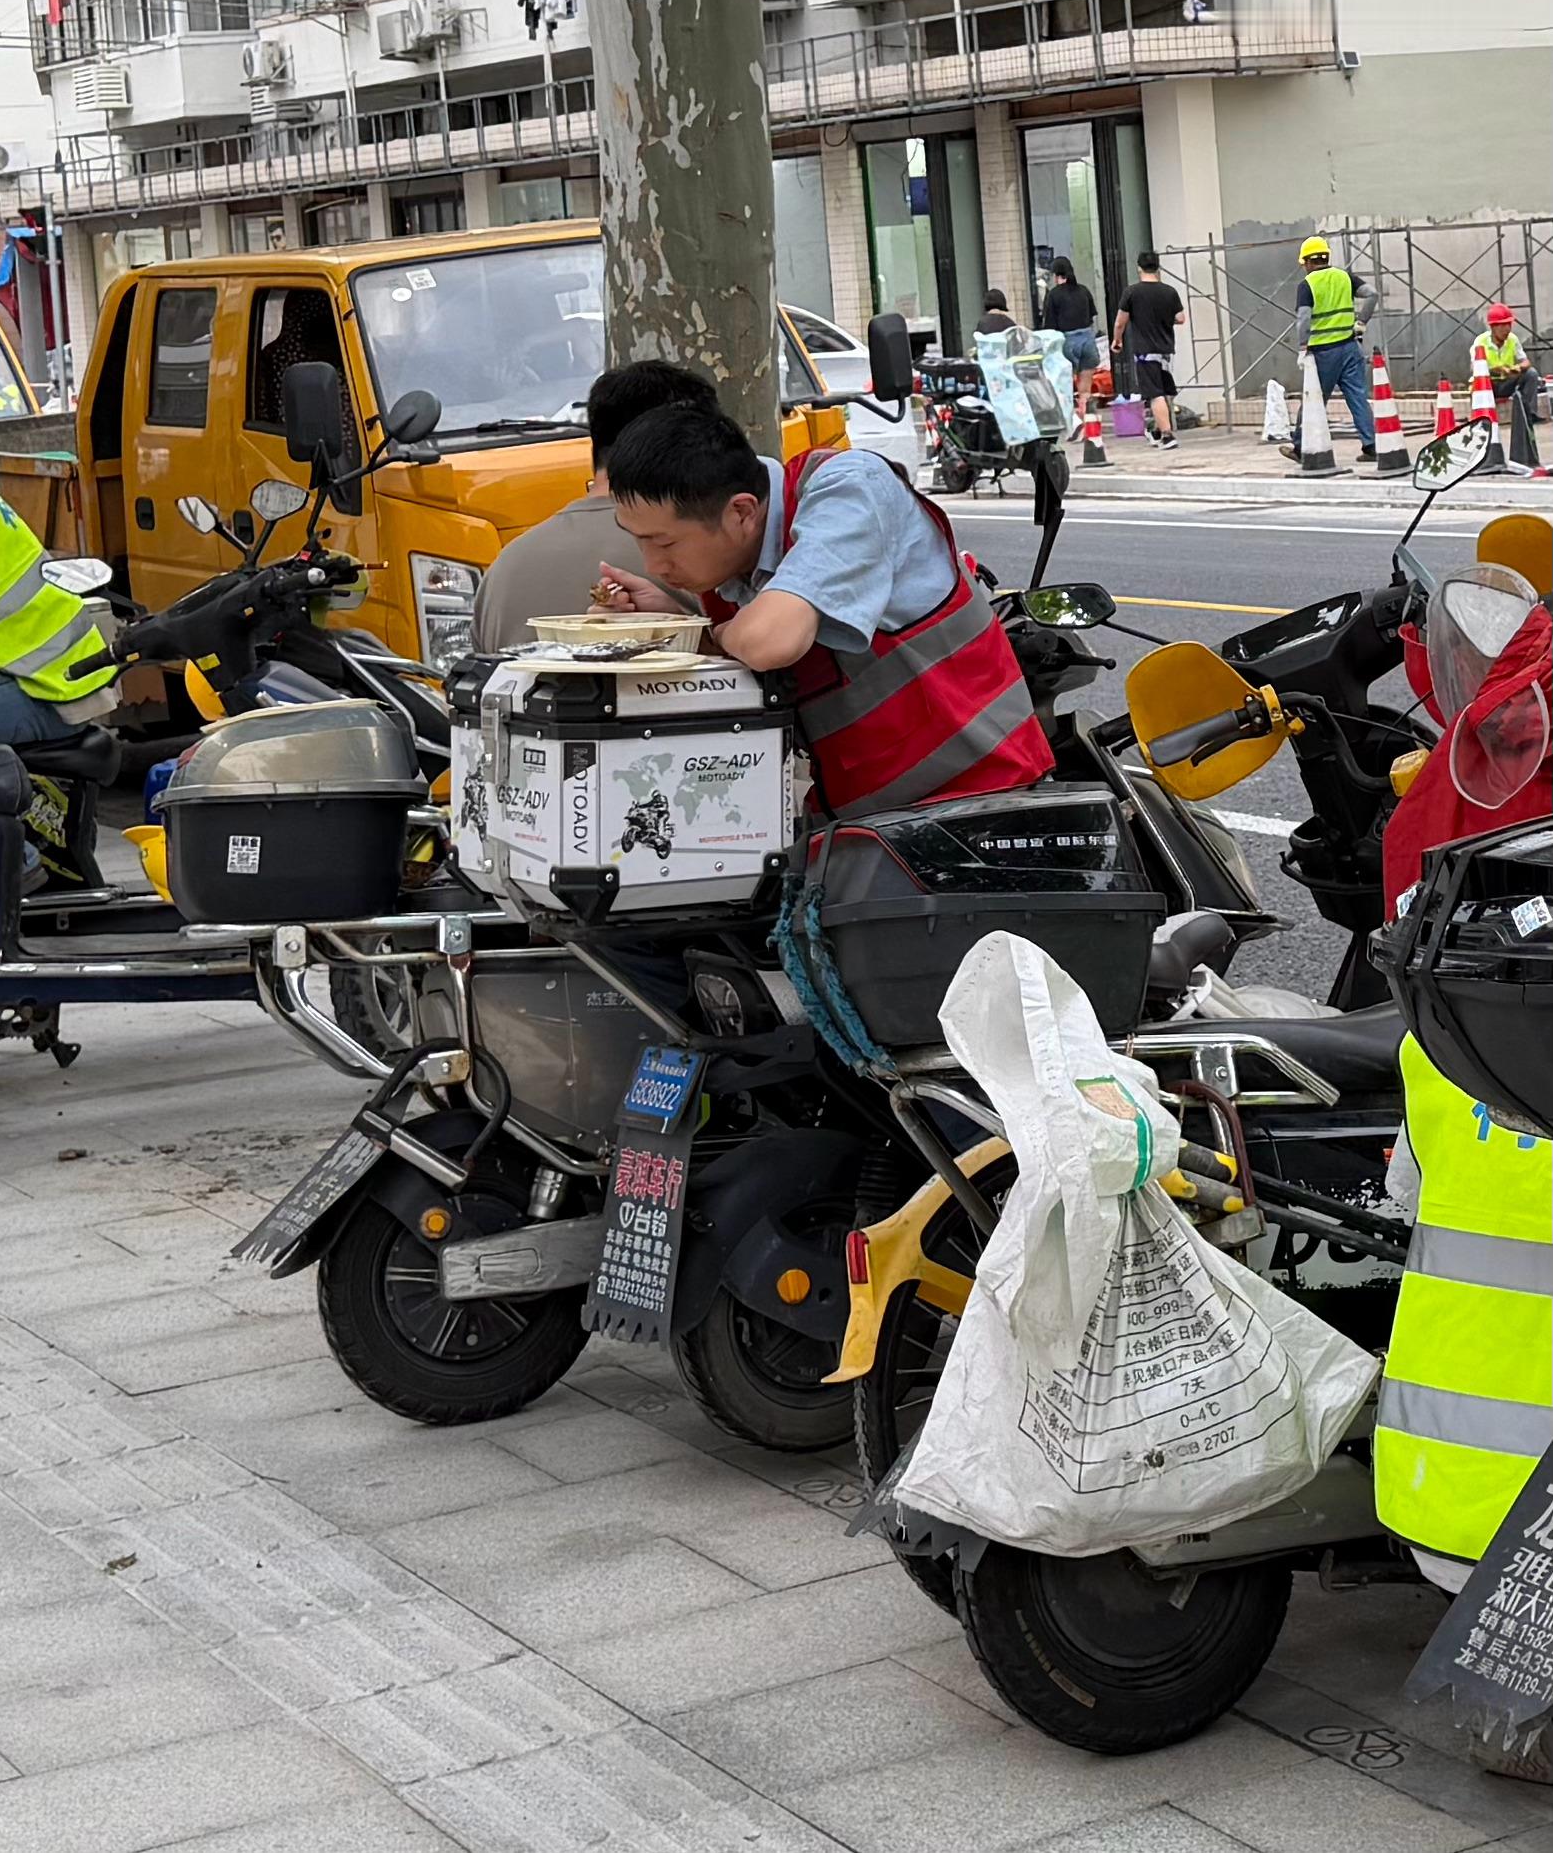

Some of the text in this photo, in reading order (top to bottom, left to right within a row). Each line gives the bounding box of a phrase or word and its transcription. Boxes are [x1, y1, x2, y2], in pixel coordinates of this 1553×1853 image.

[637, 677, 738, 696] MOTOADV
[684, 751, 765, 773] GSZ-ADV
[698, 771, 746, 783] MOTOADV
[497, 784, 550, 810] GSZ-ADV
[573, 747, 589, 854] MOTOADV
[1180, 1375, 1207, 1397] 7天
[1204, 1426, 1236, 1452] 2707
[1503, 1546, 1553, 1591] 雅
[1477, 1605, 1553, 1654] 销售:1582
[1467, 1626, 1553, 1680] 售后:5435
